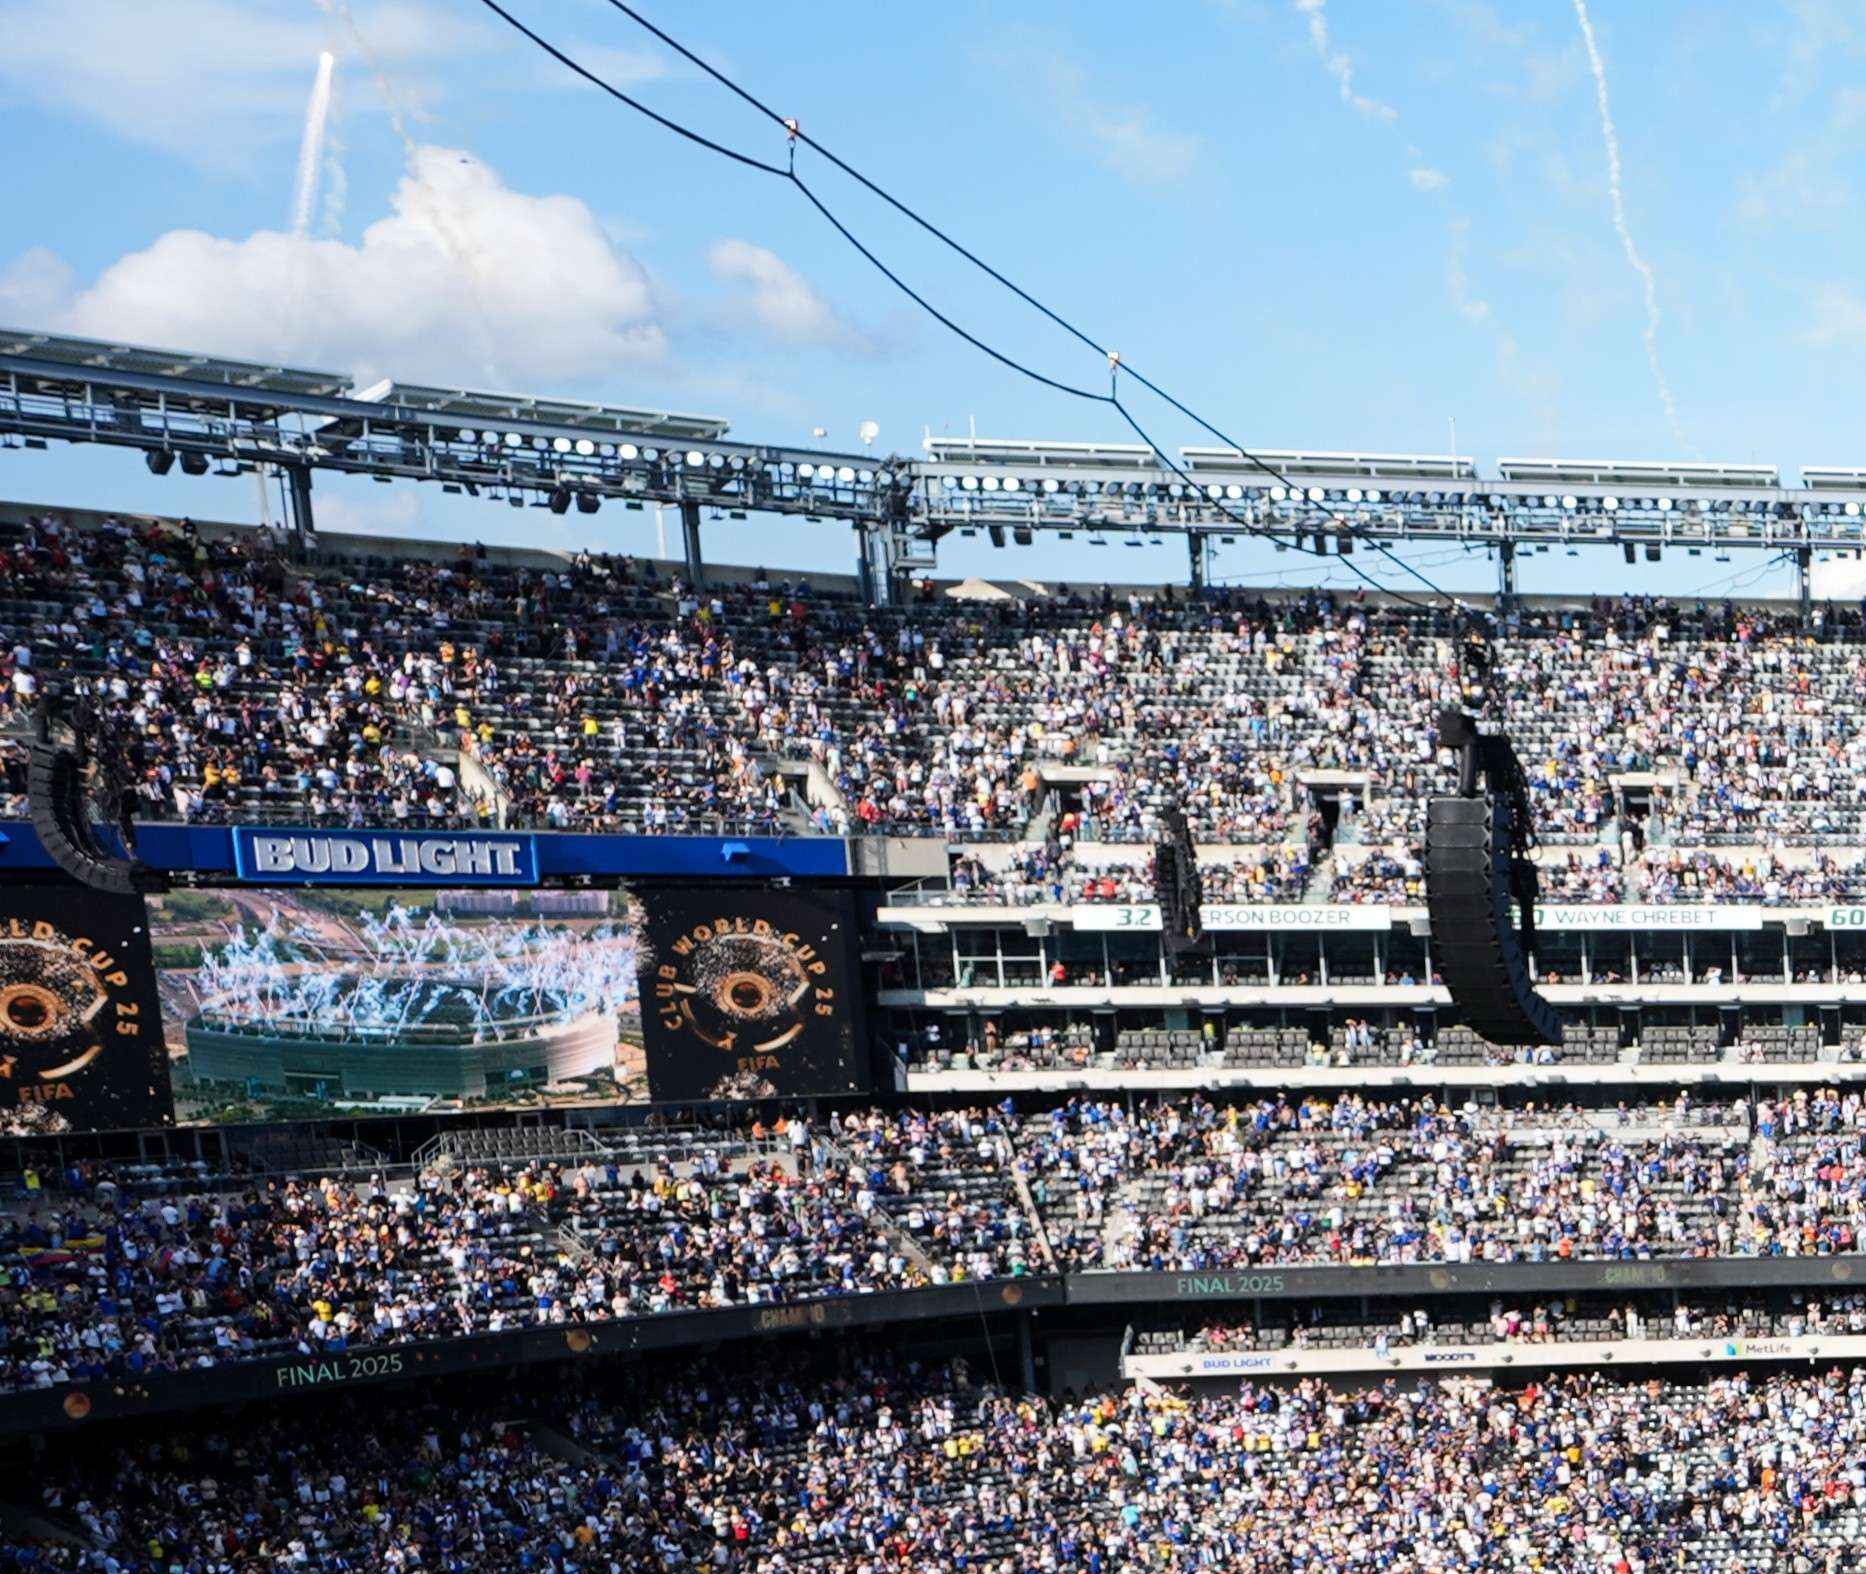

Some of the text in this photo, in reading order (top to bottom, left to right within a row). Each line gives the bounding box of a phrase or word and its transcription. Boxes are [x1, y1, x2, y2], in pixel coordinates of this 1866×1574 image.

[253, 836, 521, 875] BUD LIGHT
[1201, 910, 1263, 925] ERSON
[1270, 911, 1350, 926] BOOZER
[1554, 910, 1625, 925] WAYNE
[1630, 910, 1717, 925] CHREBET
[1831, 909, 1865, 926] 60
[1177, 1275, 1285, 1296] FINAL 2025
[1745, 1343, 1792, 1354] MetLife
[276, 1352, 404, 1389] FINAL 2025
